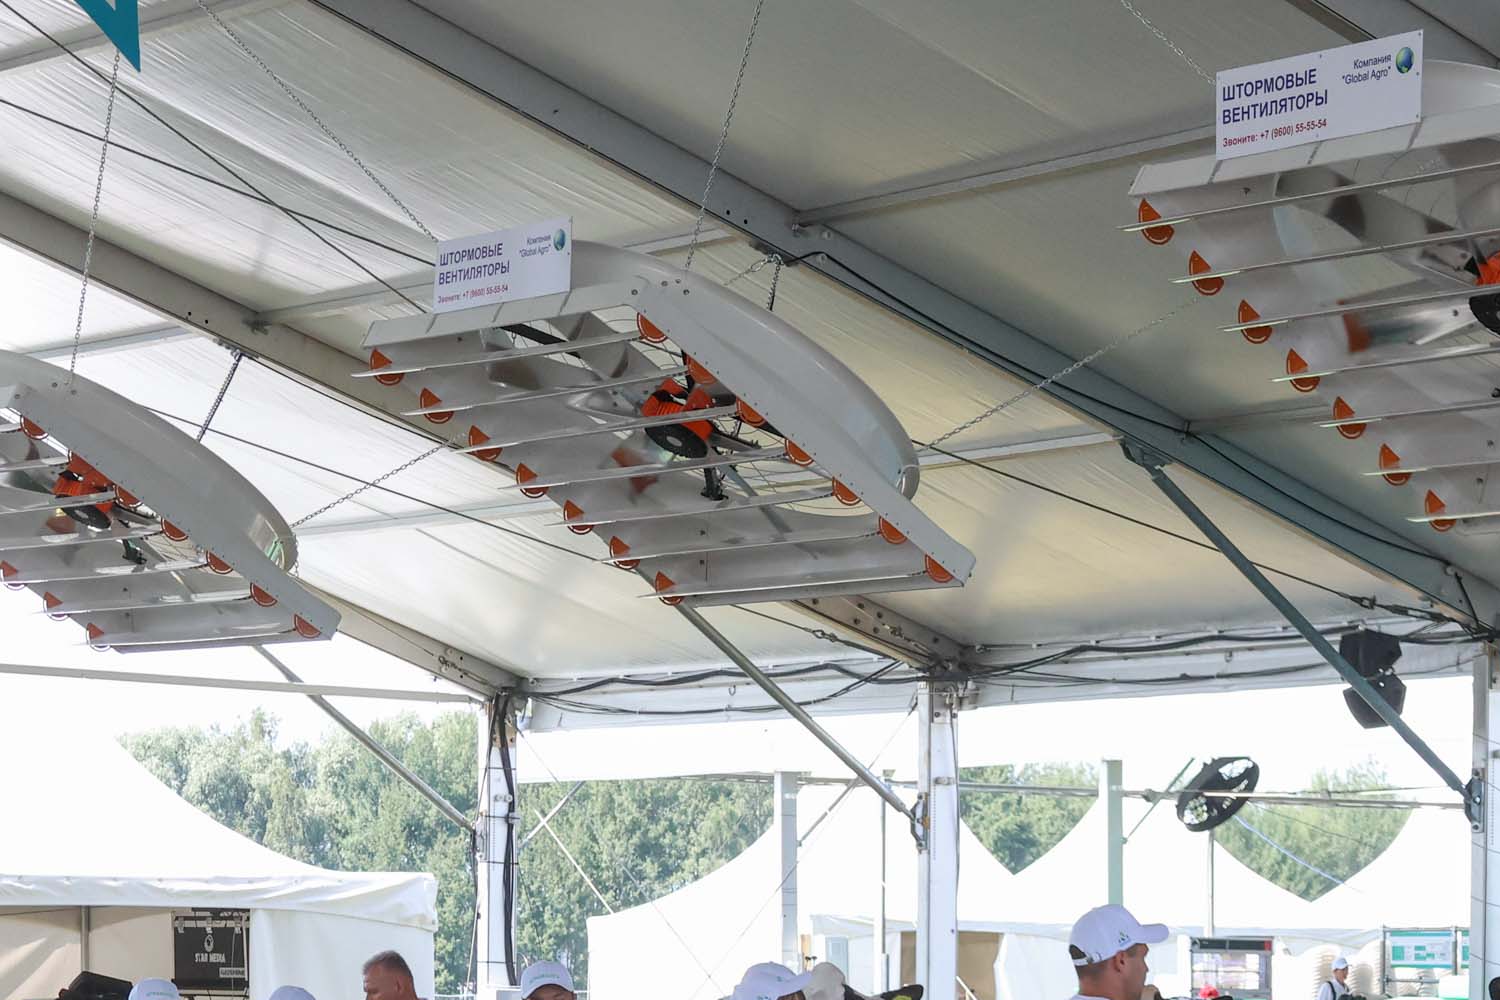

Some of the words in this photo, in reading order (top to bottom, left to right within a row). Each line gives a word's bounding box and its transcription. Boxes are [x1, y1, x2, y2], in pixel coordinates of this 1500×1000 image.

[1353, 54, 1392, 69] Компания
[1222, 68, 1317, 102] ШТОРМОВЫЕ
[1222, 89, 1328, 124] ВЕНТИЛЯТОРЫ
[1222, 134, 1258, 147] Звоните:
[1260, 130, 1270, 140] +7
[1271, 125, 1294, 140] (9600)
[1295, 119, 1327, 133] 55-55-54
[439, 243, 503, 267] ШТОРМОВЫЕ
[439, 261, 510, 285] ВЕНТИЛЯТОРЫ
